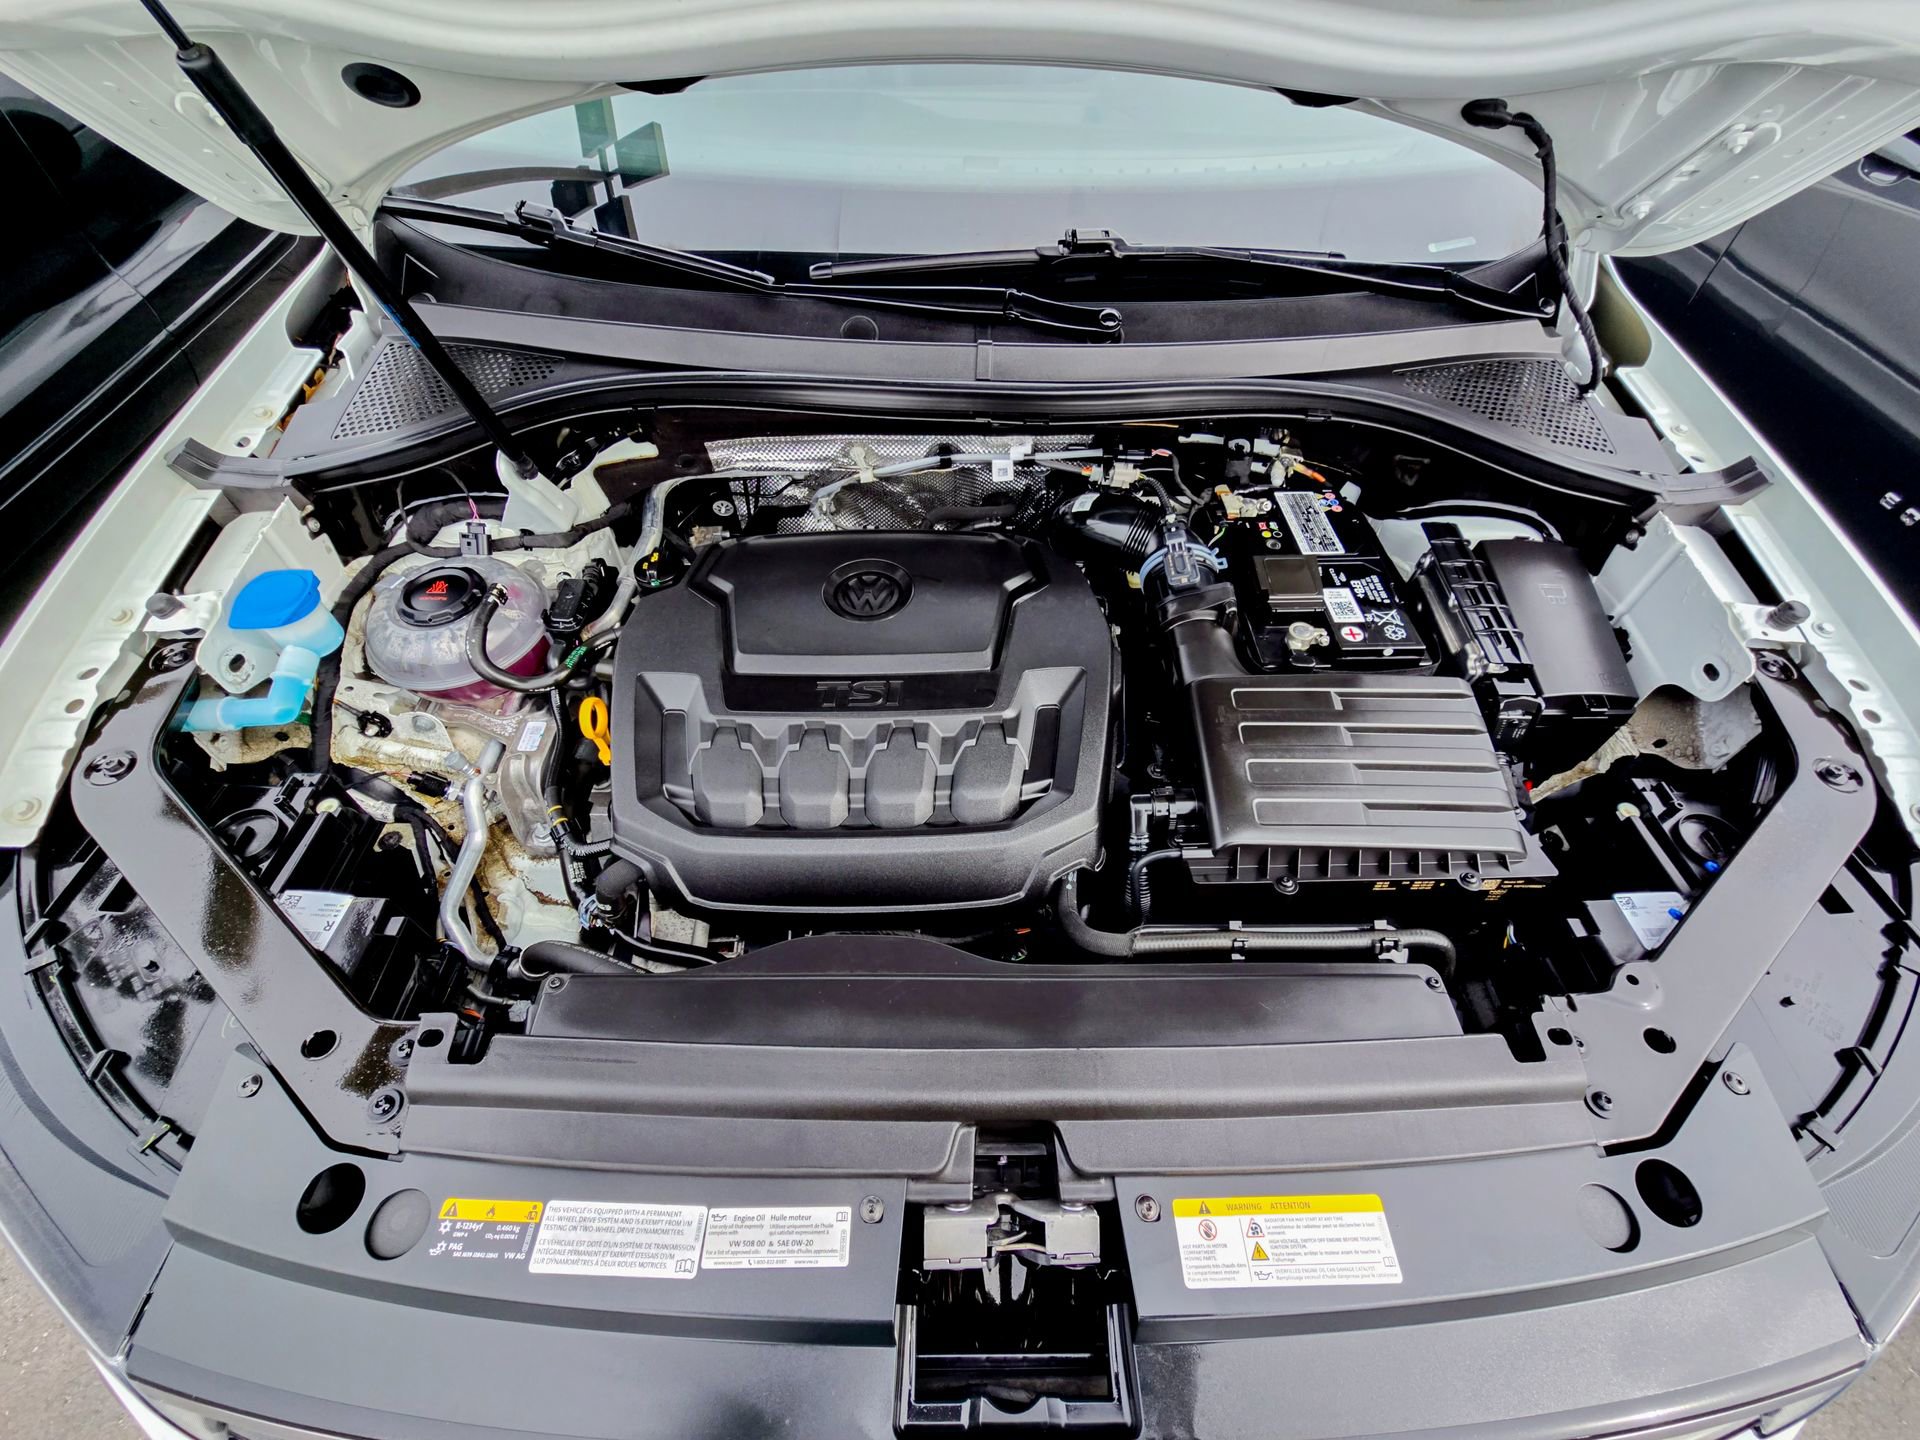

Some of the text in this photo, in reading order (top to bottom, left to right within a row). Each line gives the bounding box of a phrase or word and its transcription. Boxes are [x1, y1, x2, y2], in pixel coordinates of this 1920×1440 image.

[837, 572, 899, 616] VW
[1350, 580, 1365, 599] EFB+
[816, 680, 904, 708] TSI
[323, 921, 335, 931] R
[1226, 1202, 1310, 1211] WARNING ATTENTION
[734, 1215, 755, 1223] Engine
[456, 1222, 484, 1232] R-1234yf
[579, 1225, 615, 1233] TWO-WHEEL
[616, 1226, 635, 1234] DRIVE
[586, 1239, 602, 1247] DOTÉ
[620, 1241, 643, 1249] SYSTÈME
[653, 1243, 696, 1251] TRANSMISSION
[546, 1258, 593, 1266] DYNAMOMÈTRES
